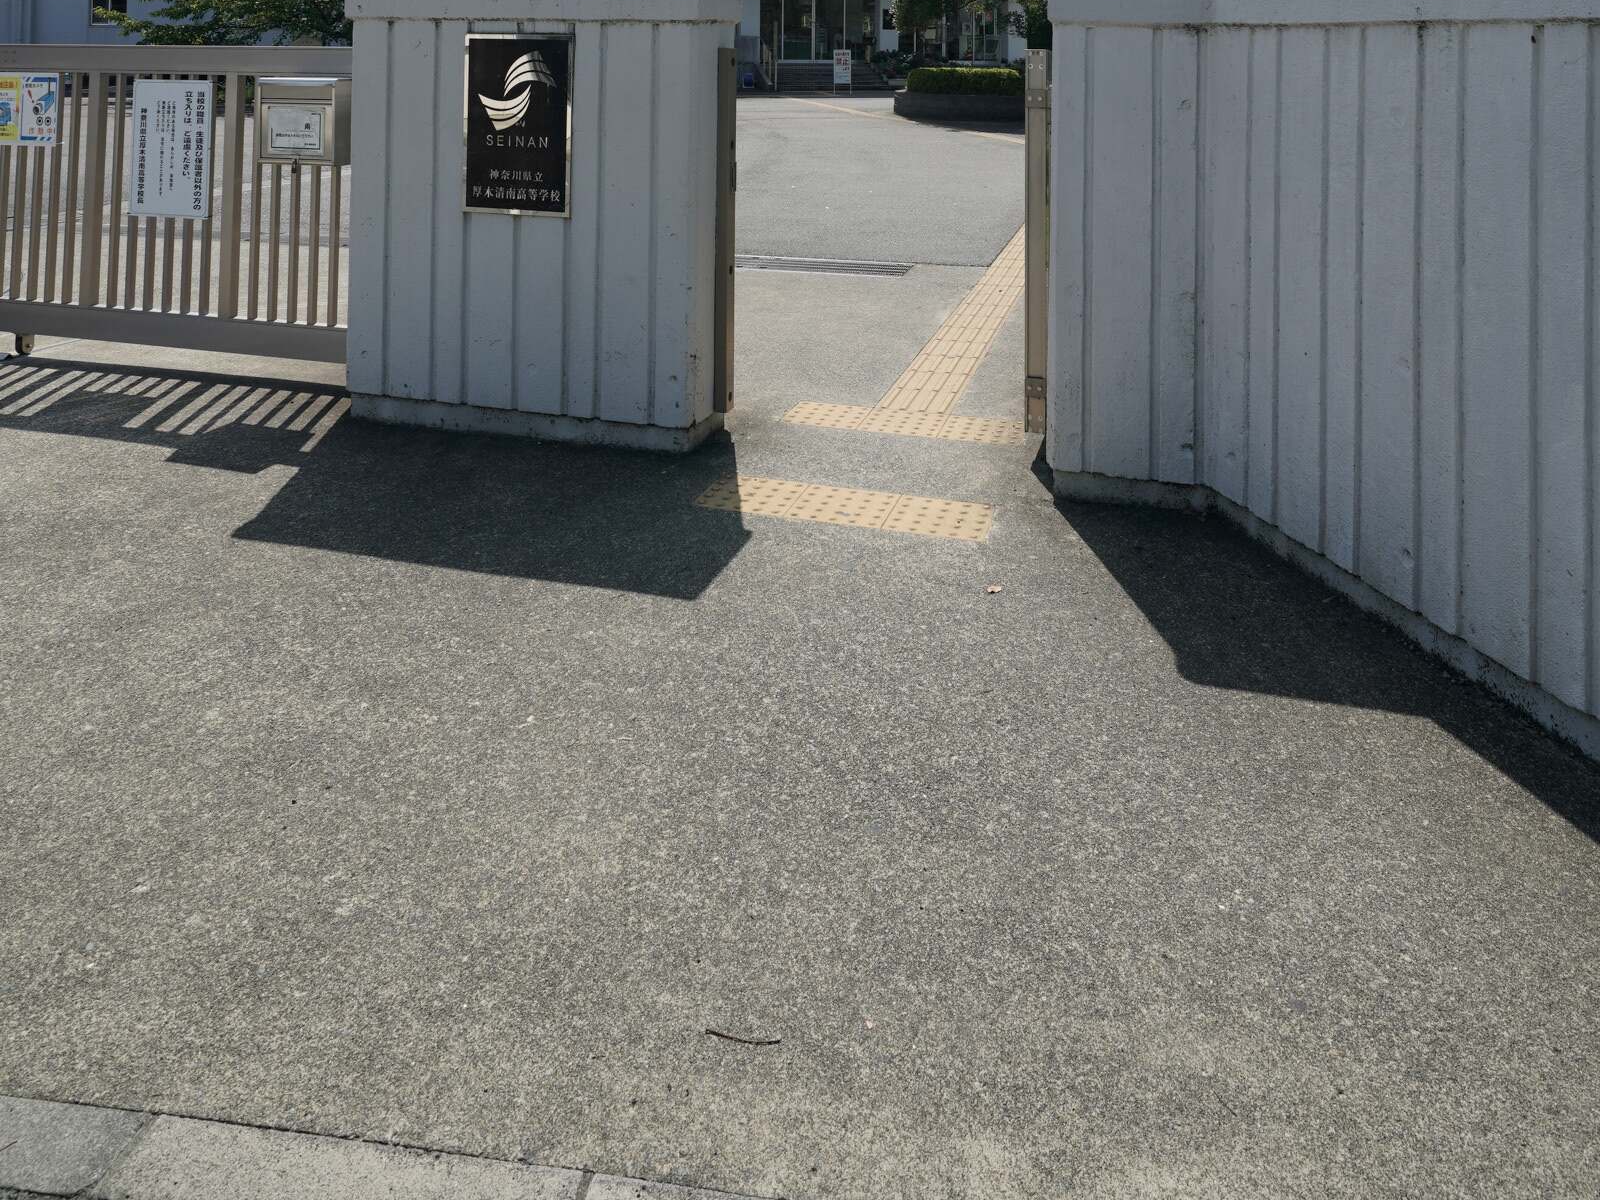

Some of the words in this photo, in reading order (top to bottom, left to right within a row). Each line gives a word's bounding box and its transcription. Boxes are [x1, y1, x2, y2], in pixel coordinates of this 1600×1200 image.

[486, 134, 548, 149] SEINAN
[489, 169, 544, 182] 神奈川県立
[472, 185, 561, 202] 厚木清南高等学校
